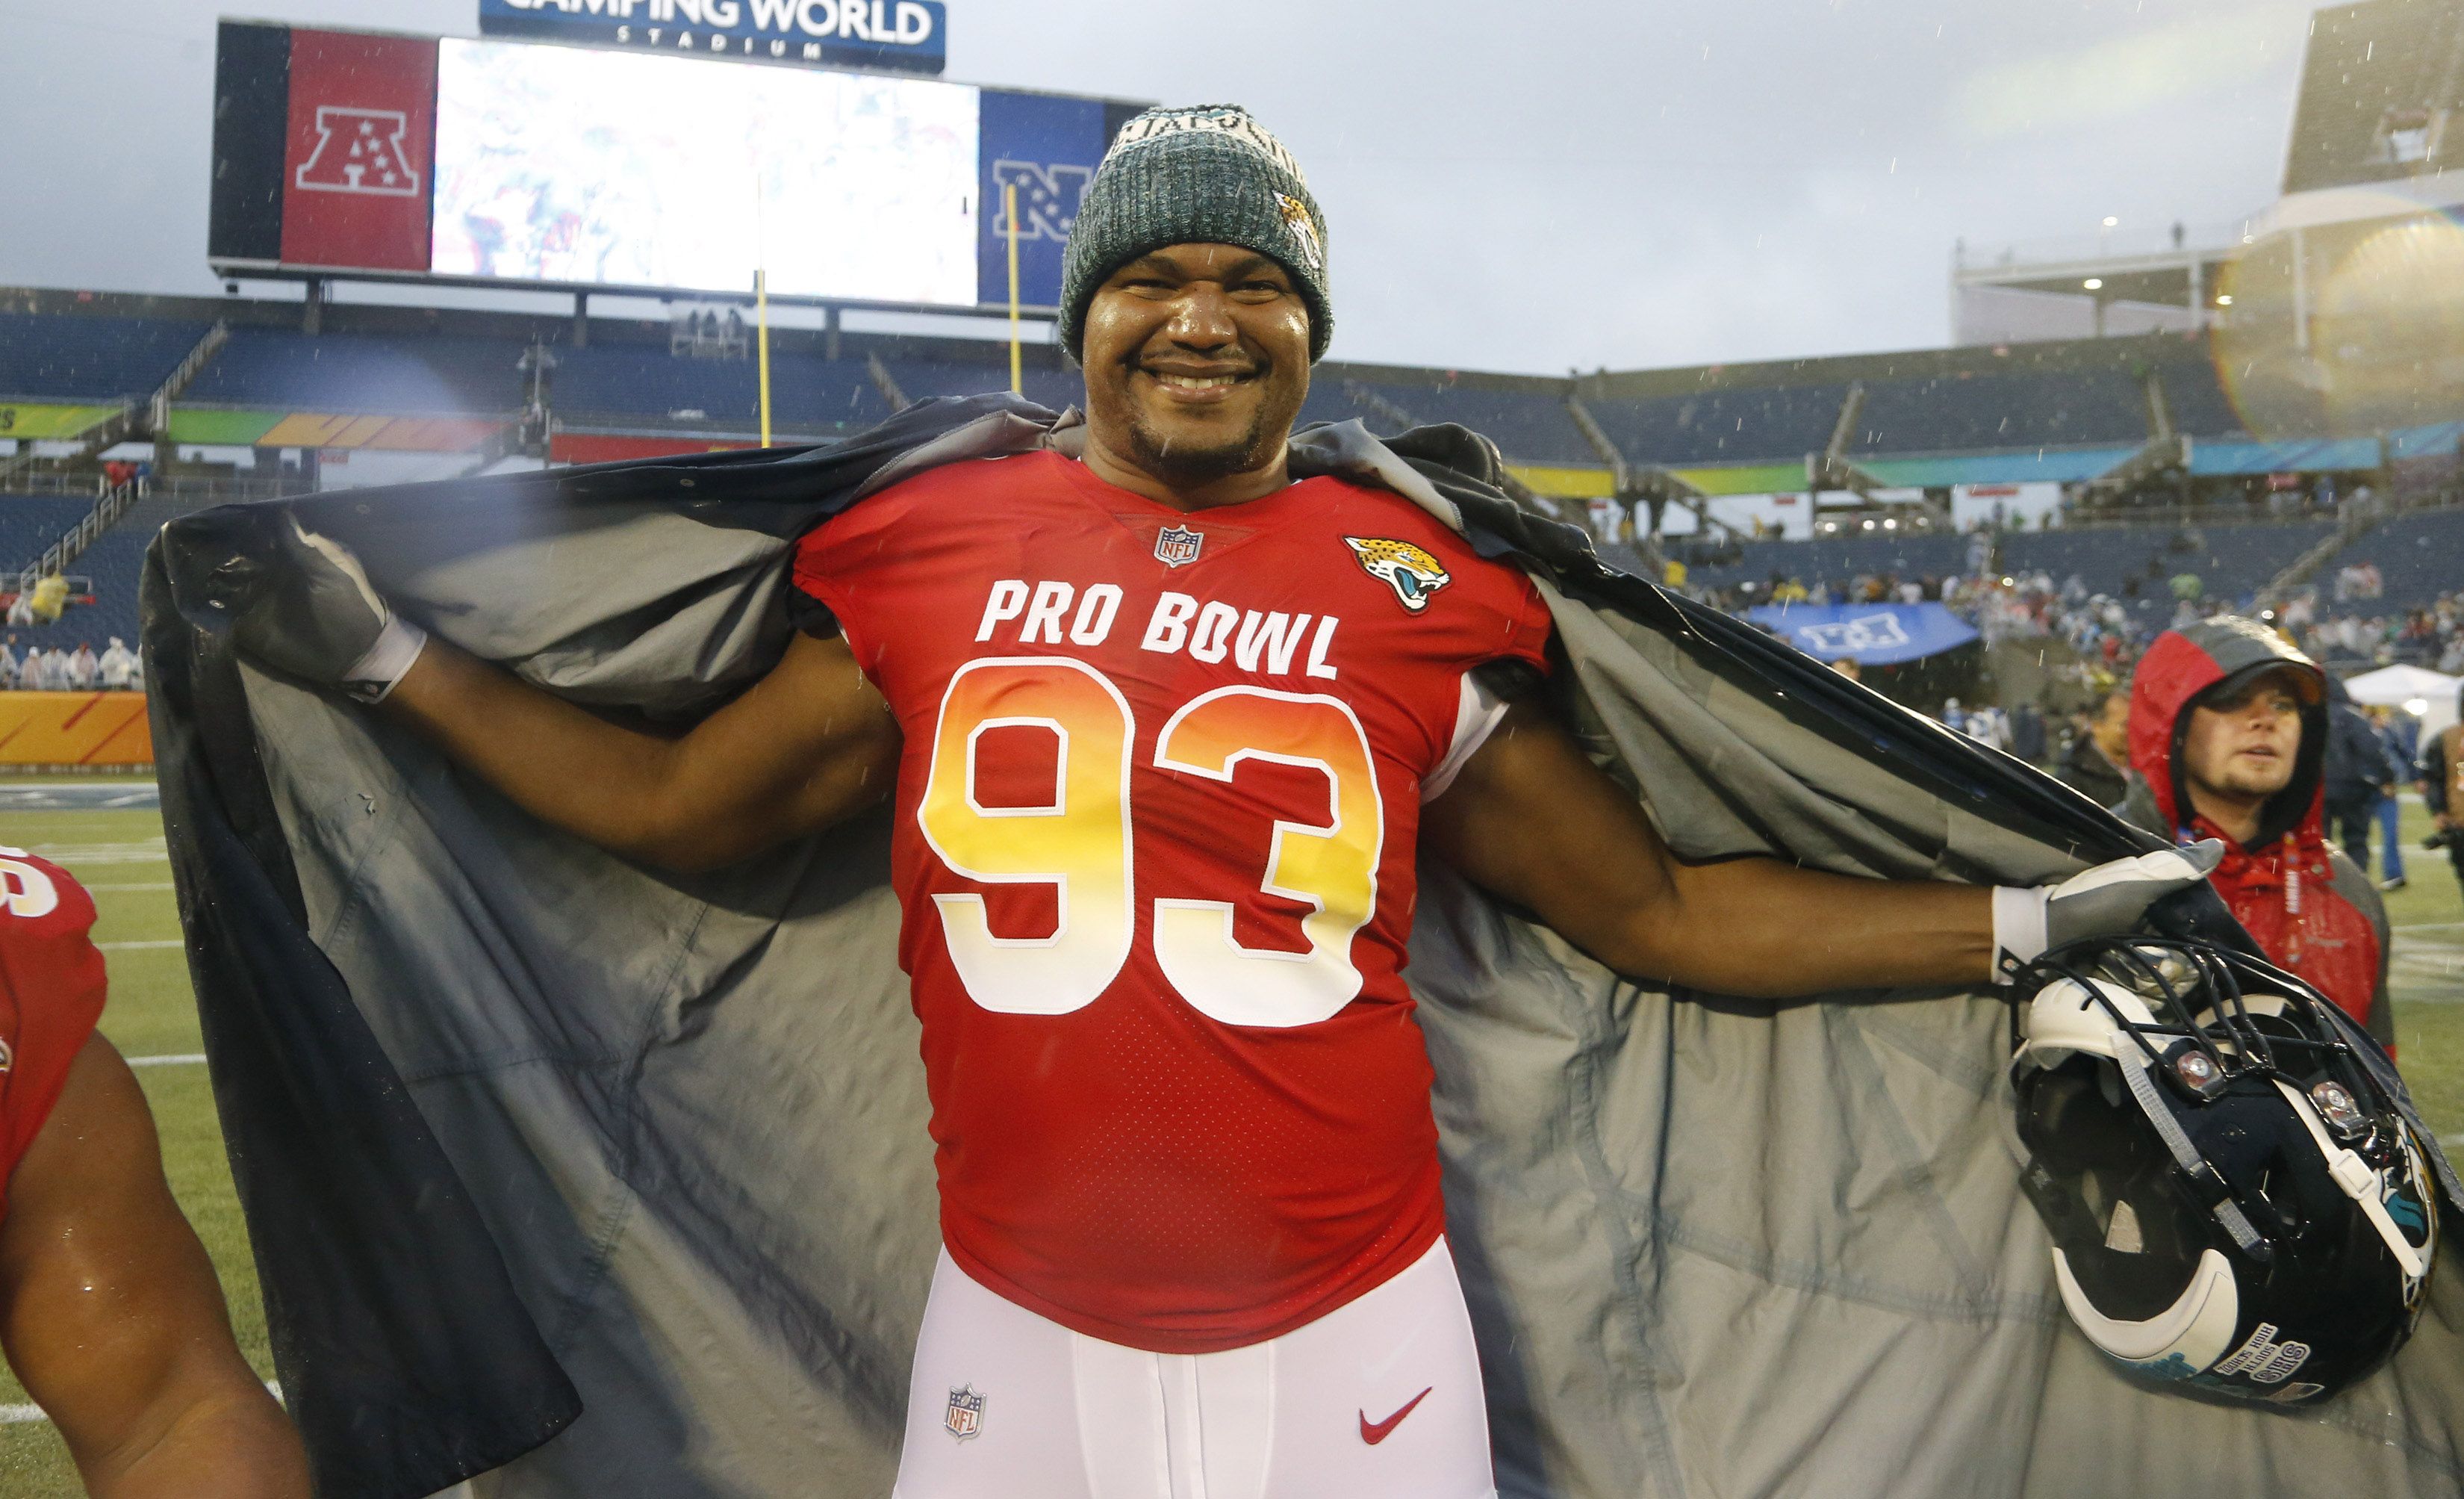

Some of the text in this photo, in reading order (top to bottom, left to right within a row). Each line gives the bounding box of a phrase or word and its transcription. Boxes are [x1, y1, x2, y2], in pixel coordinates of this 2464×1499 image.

[504, 0, 933, 45] PING WORLD
[617, 25, 822, 60] STADIUM
[1163, 541, 1192, 559] NFL
[974, 580, 1340, 680] PRO BOWL
[917, 656, 1384, 1027] 93
[2217, 1326, 2274, 1374] HIGH SCHOOL
[2244, 1344, 2276, 1371] SOUTH
[949, 1408, 974, 1431] NFL
